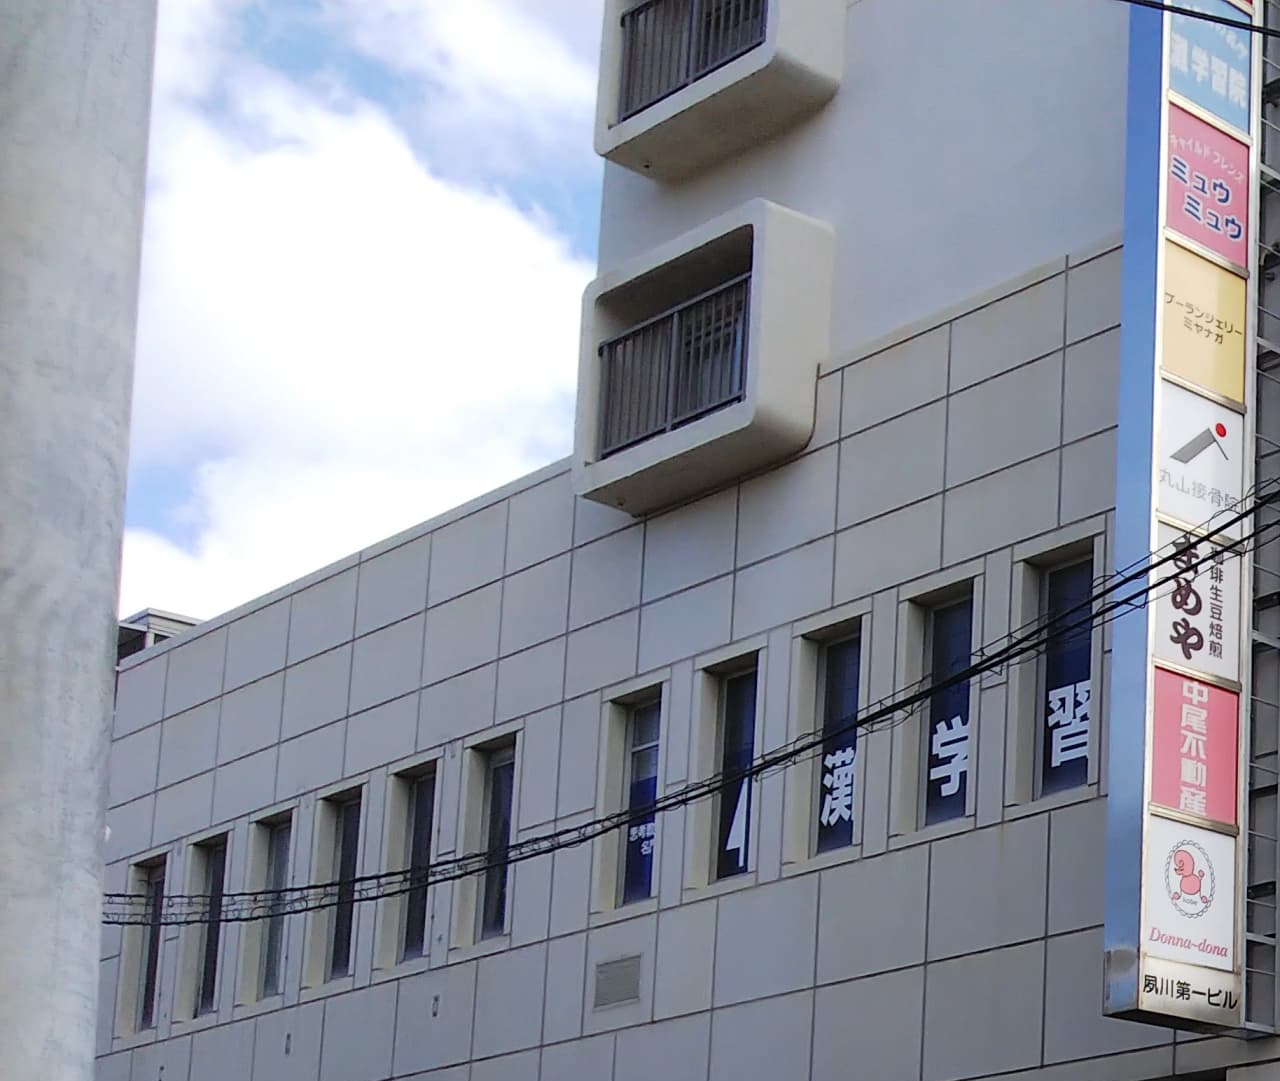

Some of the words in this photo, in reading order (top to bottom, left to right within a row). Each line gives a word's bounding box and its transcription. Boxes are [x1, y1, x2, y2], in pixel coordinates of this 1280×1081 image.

[1183, 316, 1224, 344] ミヤナガ
[1180, 680, 1209, 816] 中尾不動産
[1143, 974, 1239, 1010] 夙川第一ビル
